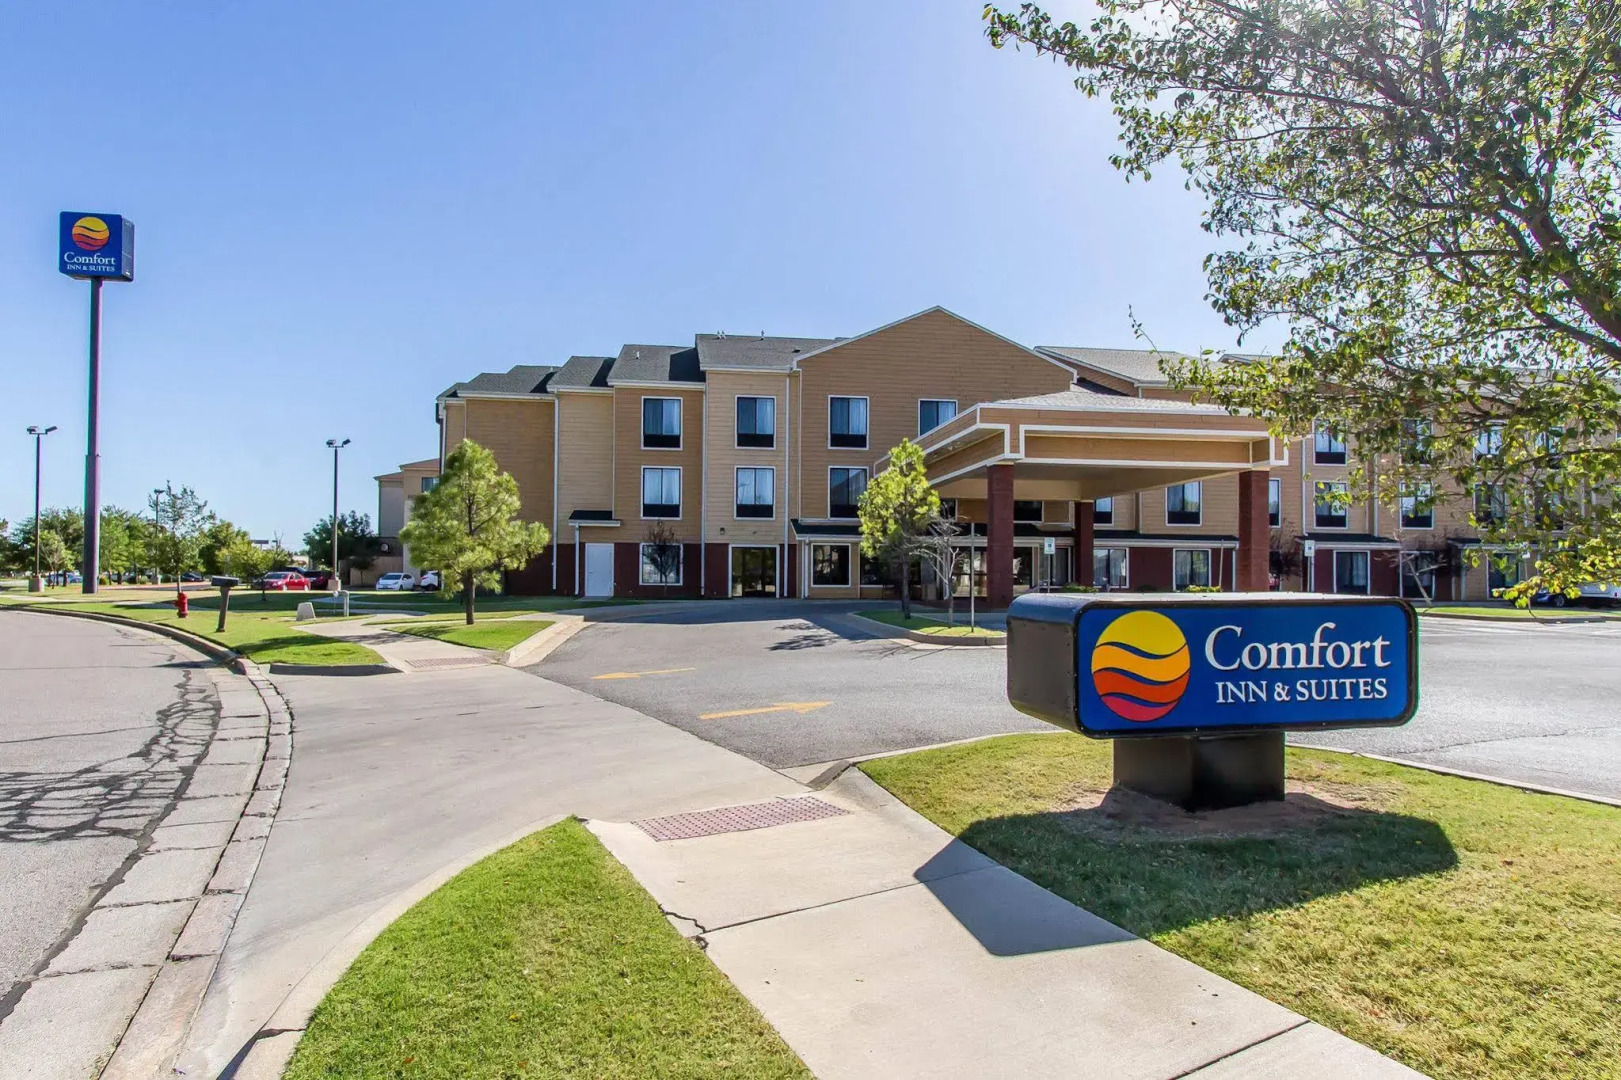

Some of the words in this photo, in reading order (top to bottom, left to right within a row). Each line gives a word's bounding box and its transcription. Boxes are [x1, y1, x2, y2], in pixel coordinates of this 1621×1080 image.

[63, 251, 116, 265] Comfort
[1205, 622, 1391, 671] Comfort
[1215, 680, 1268, 703] INN
[1274, 682, 1291, 701] &
[1296, 678, 1388, 701] SUITES
